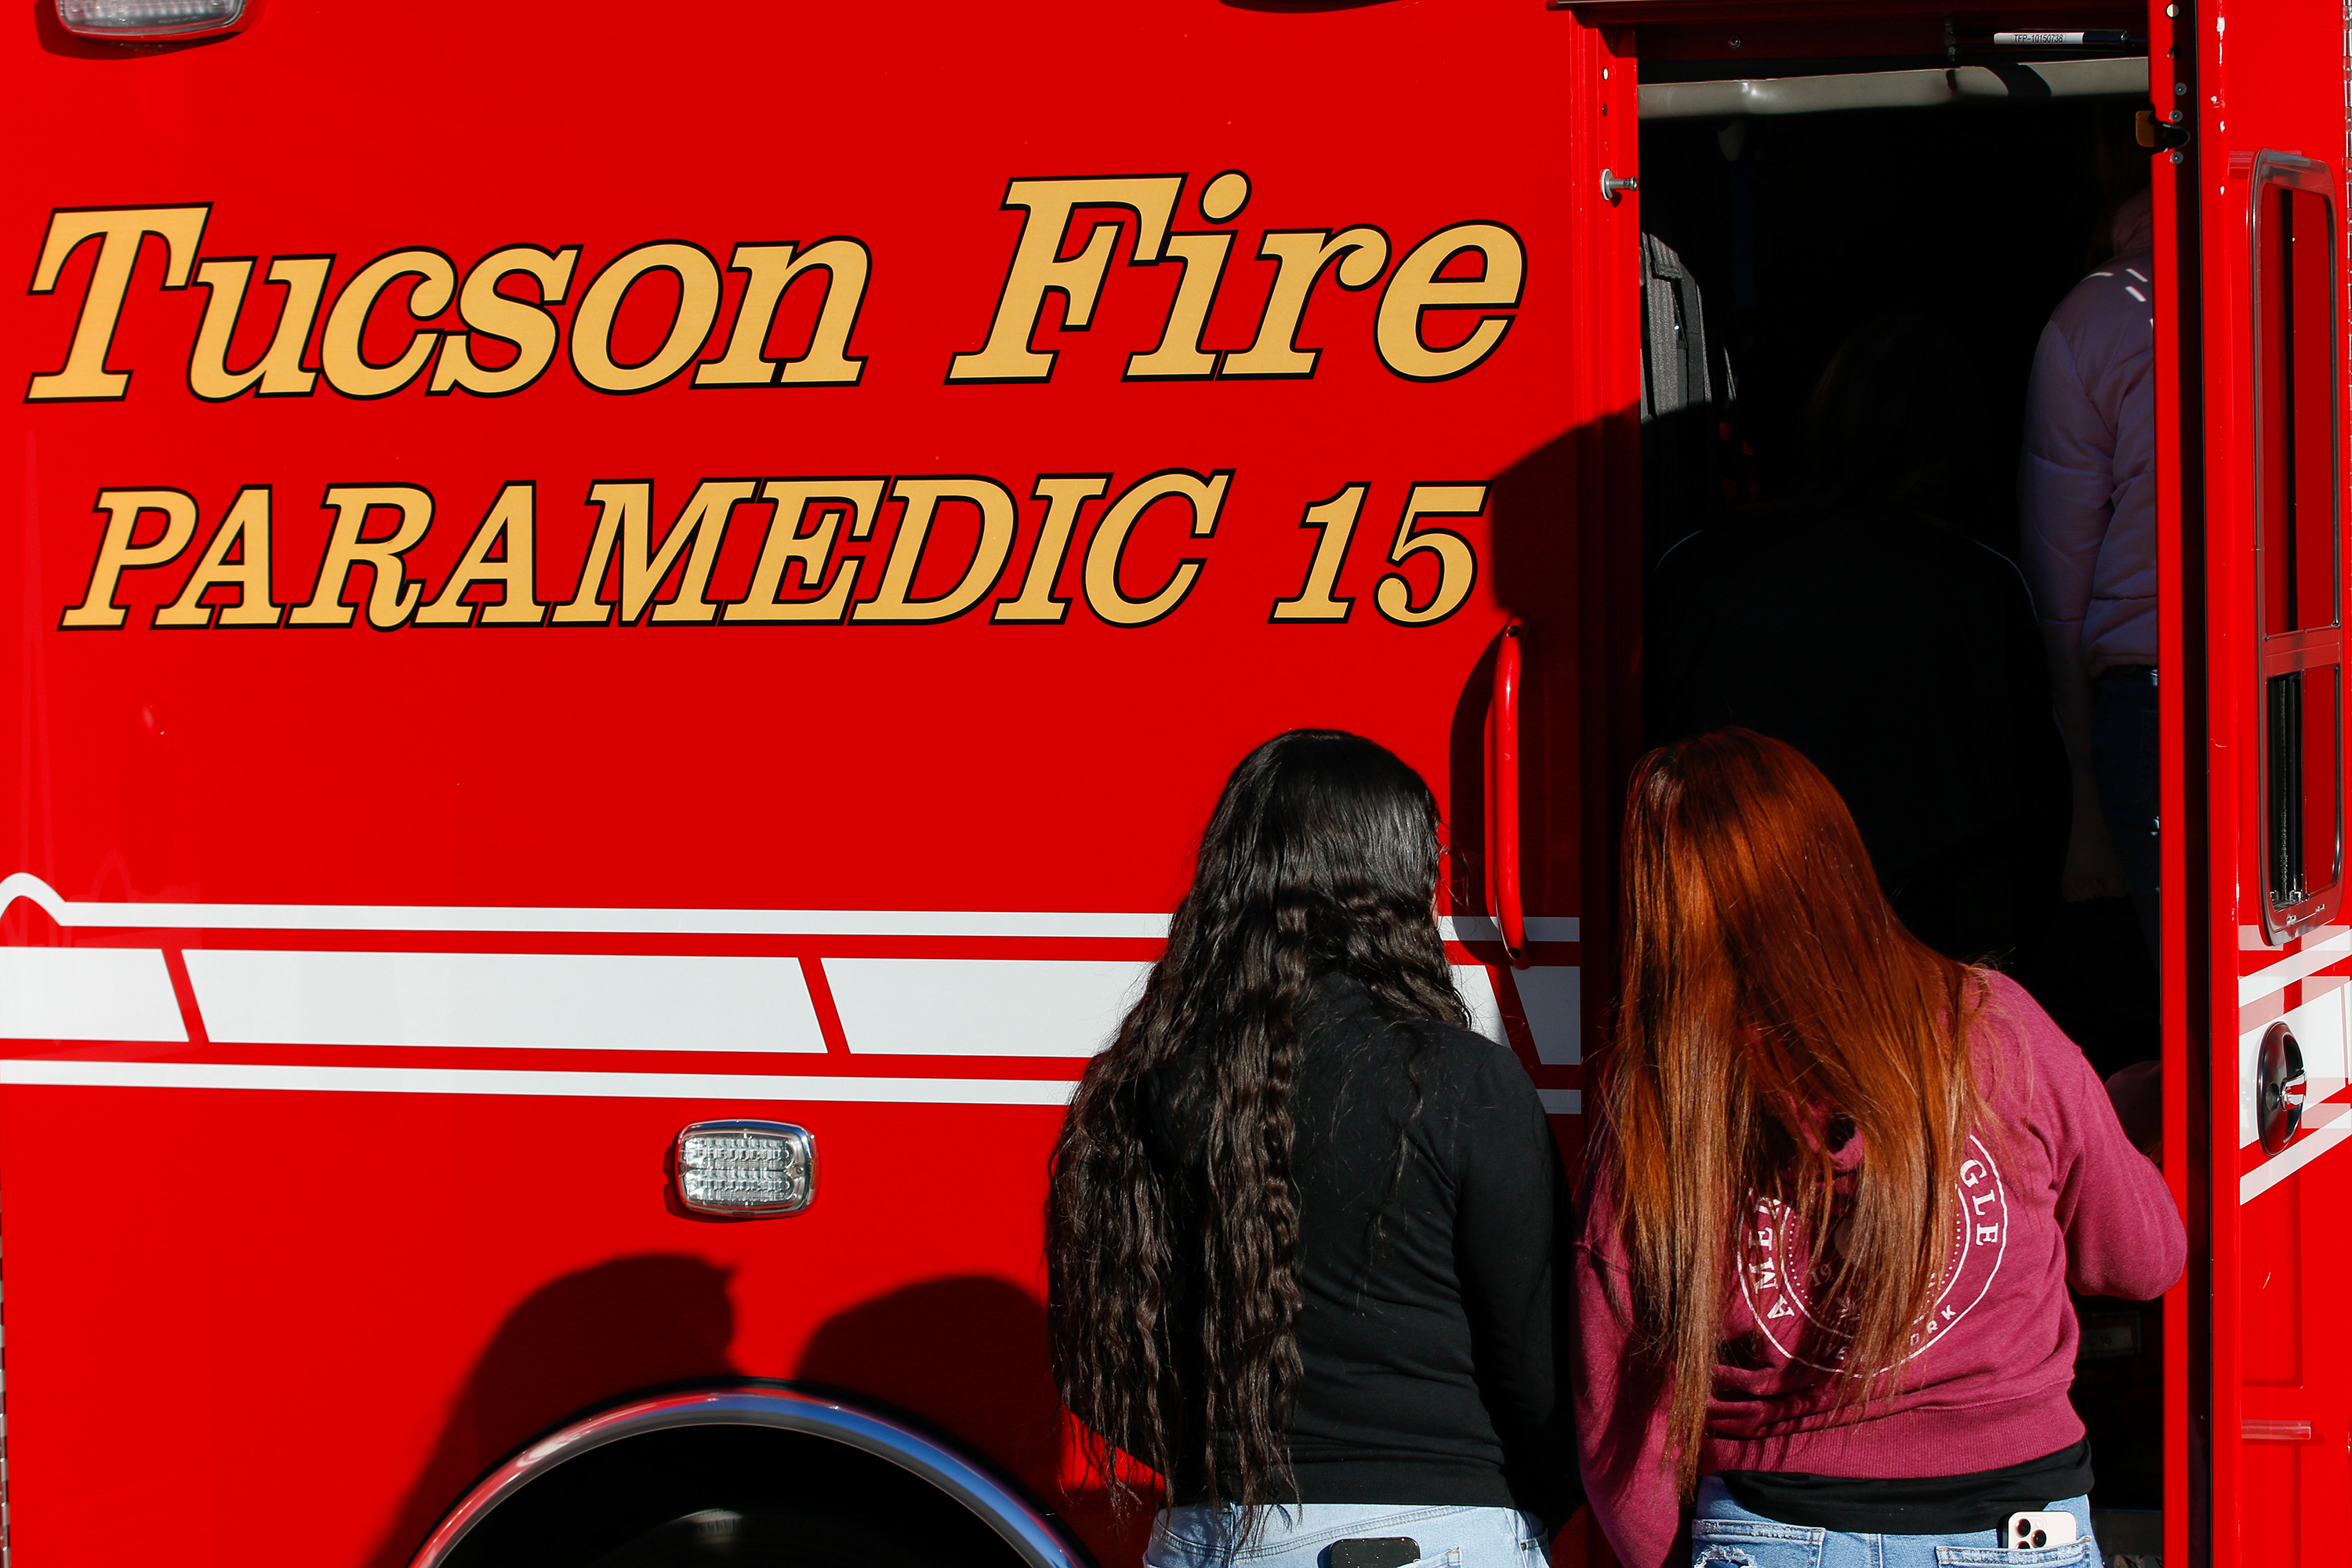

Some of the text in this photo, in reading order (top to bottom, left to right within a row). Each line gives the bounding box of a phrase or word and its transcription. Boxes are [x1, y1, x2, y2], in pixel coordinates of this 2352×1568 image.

[2014, 34, 2063, 43] TFP-10150738
[24, 169, 1527, 403] Tucson Fire
[57, 467, 1494, 631] PARAMEDIC 15
